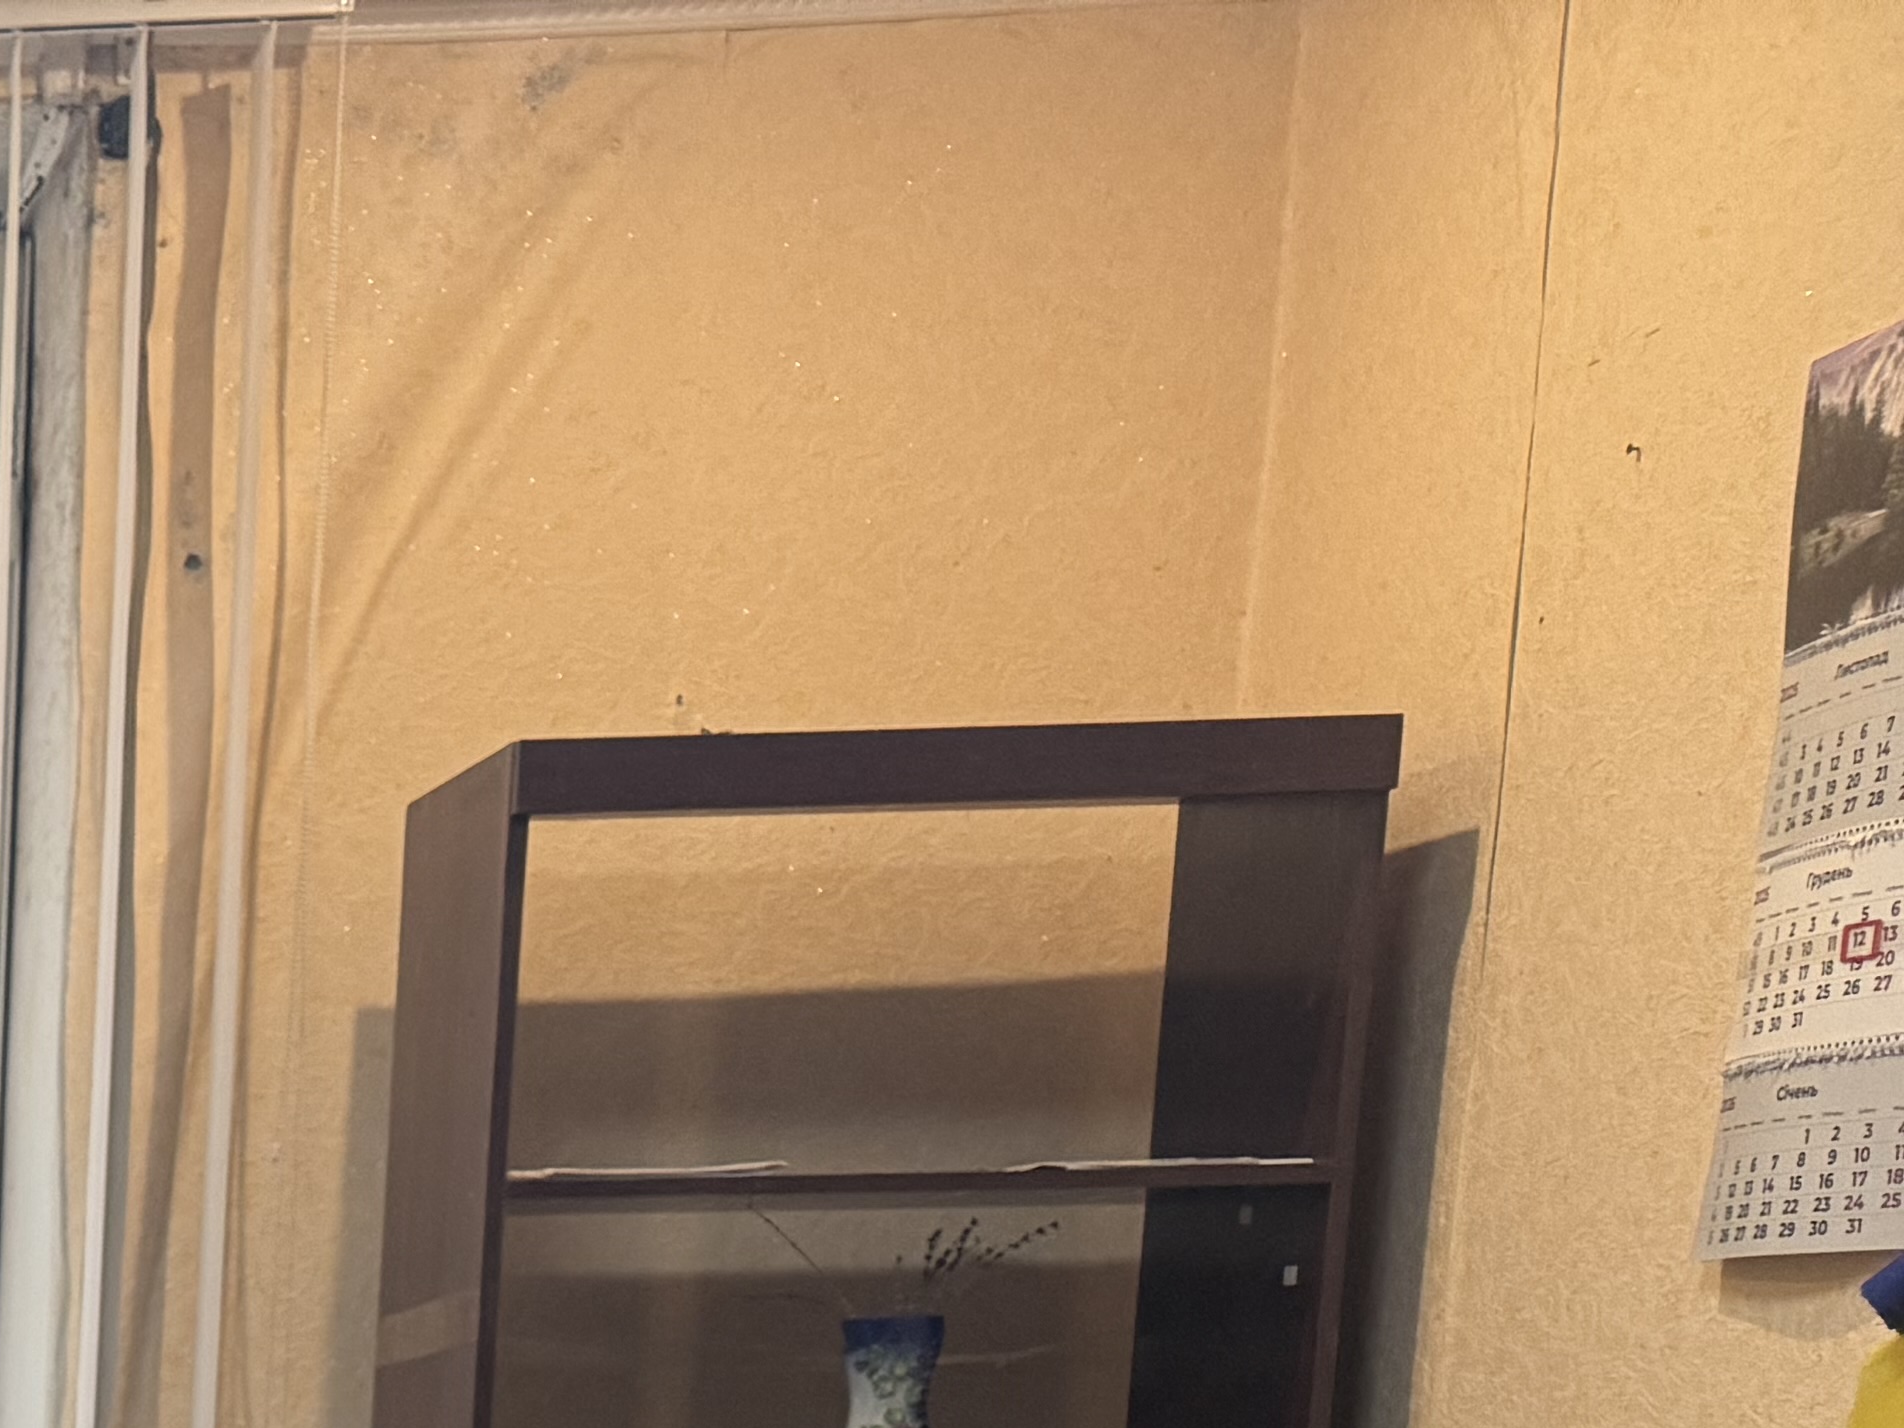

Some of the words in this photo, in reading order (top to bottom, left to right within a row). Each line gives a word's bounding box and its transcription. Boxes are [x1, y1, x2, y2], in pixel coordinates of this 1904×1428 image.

[1860, 723, 1869, 740] 6
[1887, 716, 1895, 733] 7
[1853, 748, 1865, 764] 13
[1877, 741, 1891, 758] 14
[1846, 772, 1861, 790] 20
[1874, 765, 1888, 783] 21
[1843, 796, 1858, 814] 27
[1867, 790, 1885, 808] 28
[1789, 923, 1797, 938] 2
[1808, 917, 1817, 932] 3
[1832, 911, 1840, 926] 4
[1861, 906, 1870, 922] 5
[1891, 900, 1902, 916] 6
[1828, 936, 1837, 952] 11
[1853, 931, 1866, 948] 12
[1883, 925, 1899, 941] 13
[1799, 965, 1809, 981] 17
[1821, 960, 1834, 976] 18
[1876, 951, 1895, 967] 20
[1773, 993, 1785, 1009] 23
[1792, 989, 1805, 1005] 24
[1816, 984, 1831, 1000] 25
[1843, 979, 1861, 996] 26
[1873, 975, 1893, 992] 27
[1769, 1016, 1781, 1033] 30
[1792, 1011, 1803, 1028] 31
[1777, 1084, 1818, 1101] Січень
[1805, 1128, 1810, 1145] 1
[1831, 1126, 1841, 1141] 2
[1863, 1123, 1873, 1139] 3
[1750, 1157, 1757, 1172] 6
[1772, 1155, 1779, 1170] 7
[1797, 1152, 1806, 1168] 8
[1828, 1149, 1837, 1165] 9
[1854, 1146, 1871, 1163] 10
[1762, 1178, 1774, 1194] 14
[1789, 1176, 1802, 1191] 15
[1819, 1173, 1834, 1189] 16
[1852, 1171, 1868, 1187] 17
[1887, 1168, 1904, 1184] 18
[1760, 1202, 1772, 1217] 21
[1783, 1199, 1799, 1215] 22
[1813, 1197, 1831, 1212] 23
[1844, 1195, 1864, 1211] 24
[1880, 1193, 1902, 1208] 25
[1734, 1226, 1746, 1242] 27
[1753, 1224, 1768, 1240] 28
[1778, 1222, 1795, 1238] 29
[1808, 1220, 1828, 1236] 30
[1845, 1218, 1863, 1234] 31
